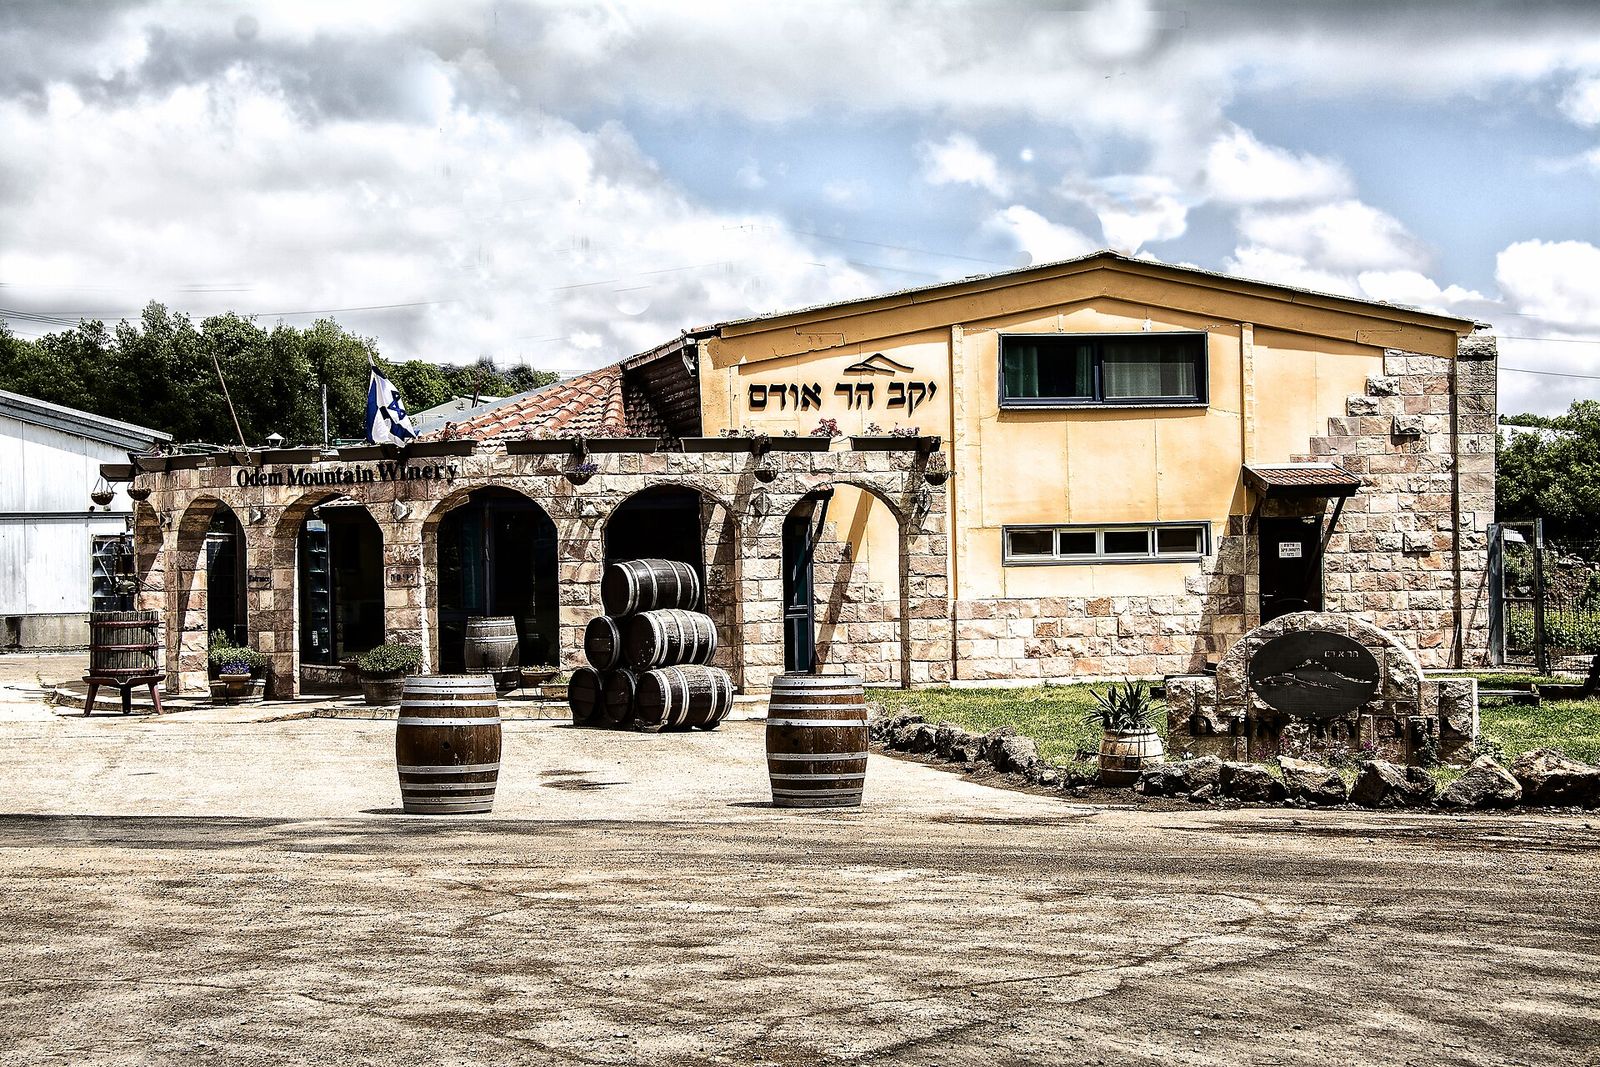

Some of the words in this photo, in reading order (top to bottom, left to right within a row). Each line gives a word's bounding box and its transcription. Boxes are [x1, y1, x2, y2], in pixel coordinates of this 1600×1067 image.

[749, 382, 822, 411] אודם
[834, 382, 874, 411] הר
[887, 381, 937, 418] יקב
[236, 468, 283, 487] Odem
[286, 464, 374, 487] Mountain
[377, 461, 458, 484] Winery
